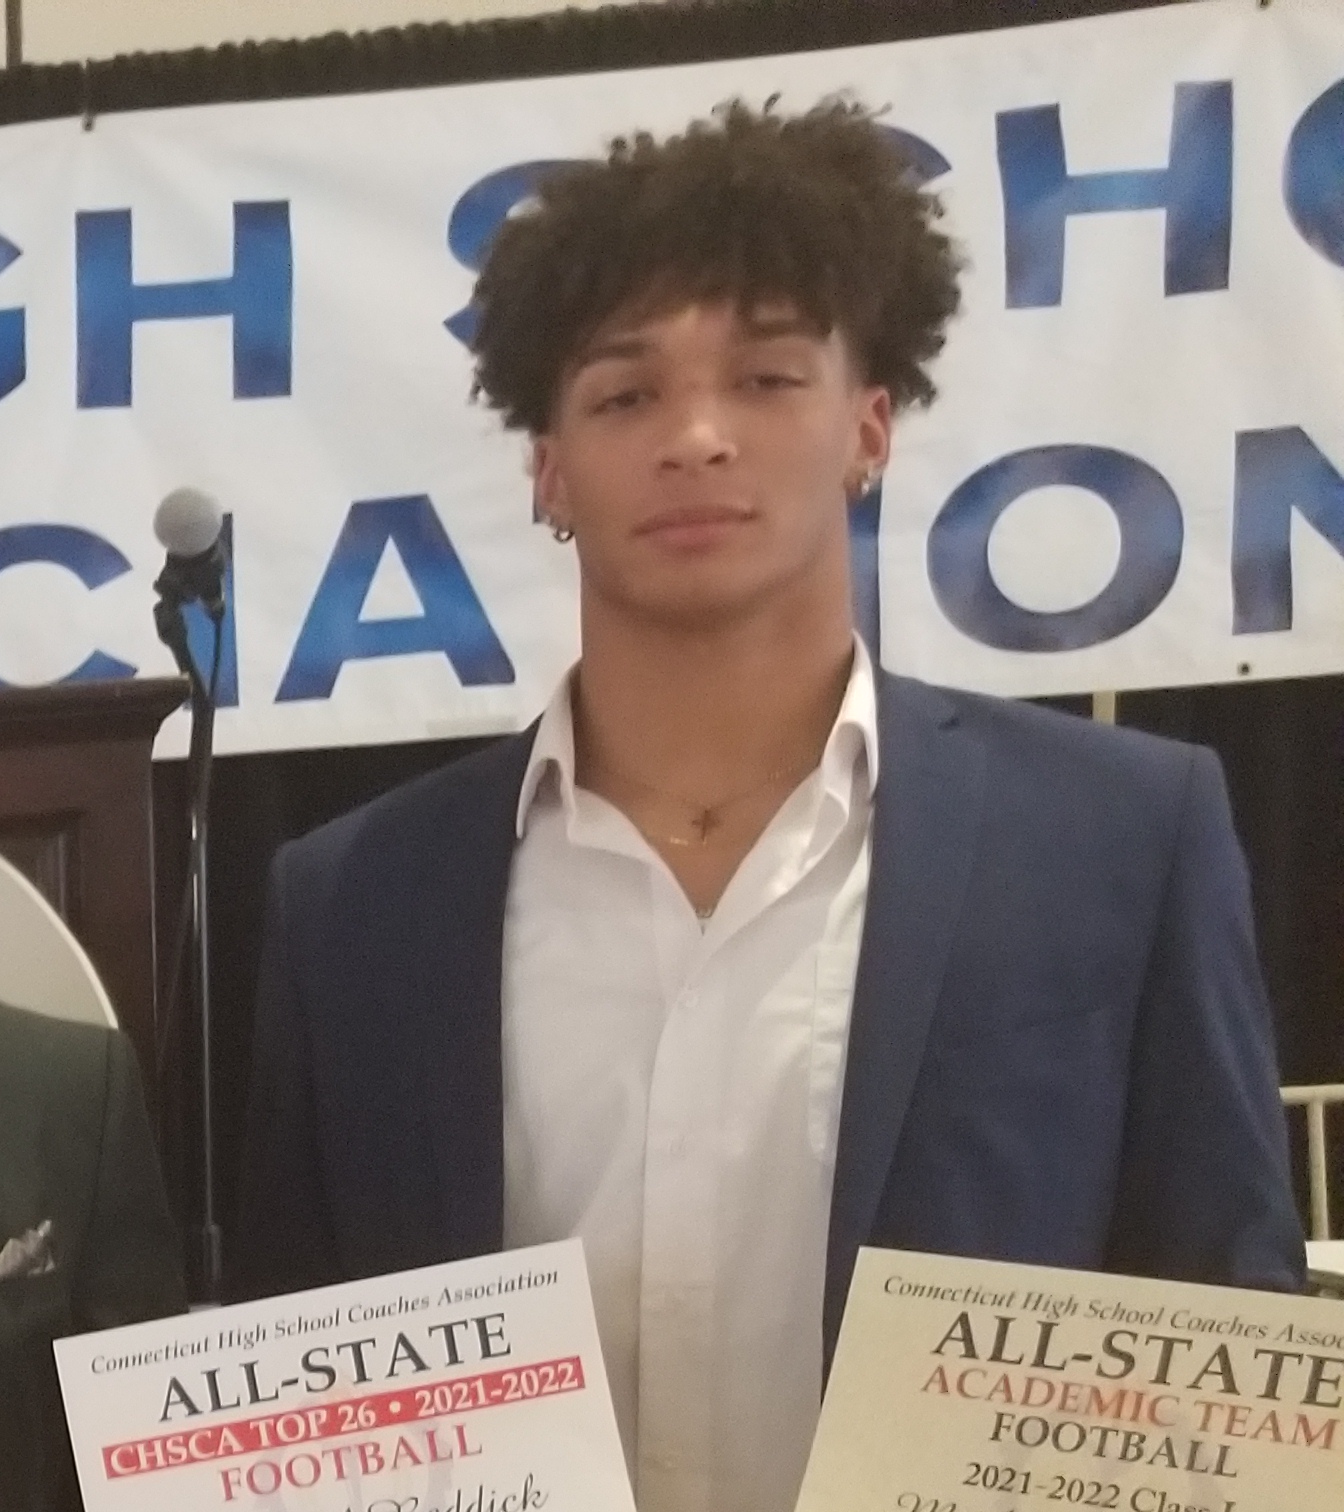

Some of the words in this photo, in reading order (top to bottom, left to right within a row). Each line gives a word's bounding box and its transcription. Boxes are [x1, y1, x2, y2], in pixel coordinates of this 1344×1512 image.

[90, 1336, 210, 1375] Connecticut
[218, 1321, 268, 1350] High
[273, 1309, 340, 1338] School
[348, 1295, 430, 1325] Coaches
[437, 1268, 559, 1306] Association
[883, 1275, 1017, 1309] Connecticut
[1020, 1290, 1080, 1319] High
[1083, 1299, 1165, 1327] School
[1169, 1309, 1266, 1340] Coaches
[159, 1313, 513, 1422] ALL-STATE
[930, 1310, 1343, 1409] ALL-STATE
[109, 1430, 245, 1476] CHSCA
[249, 1413, 329, 1451] TOP
[339, 1402, 377, 1433] 26
[415, 1363, 579, 1418] 2021-2022
[921, 1364, 1180, 1427] ACADEMIC
[1193, 1401, 1340, 1451] TEAM
[989, 1412, 1239, 1478] FOOTBALL
[220, 1421, 483, 1502] FOOTBALL
[961, 1462, 1119, 1510] 2021-2022
